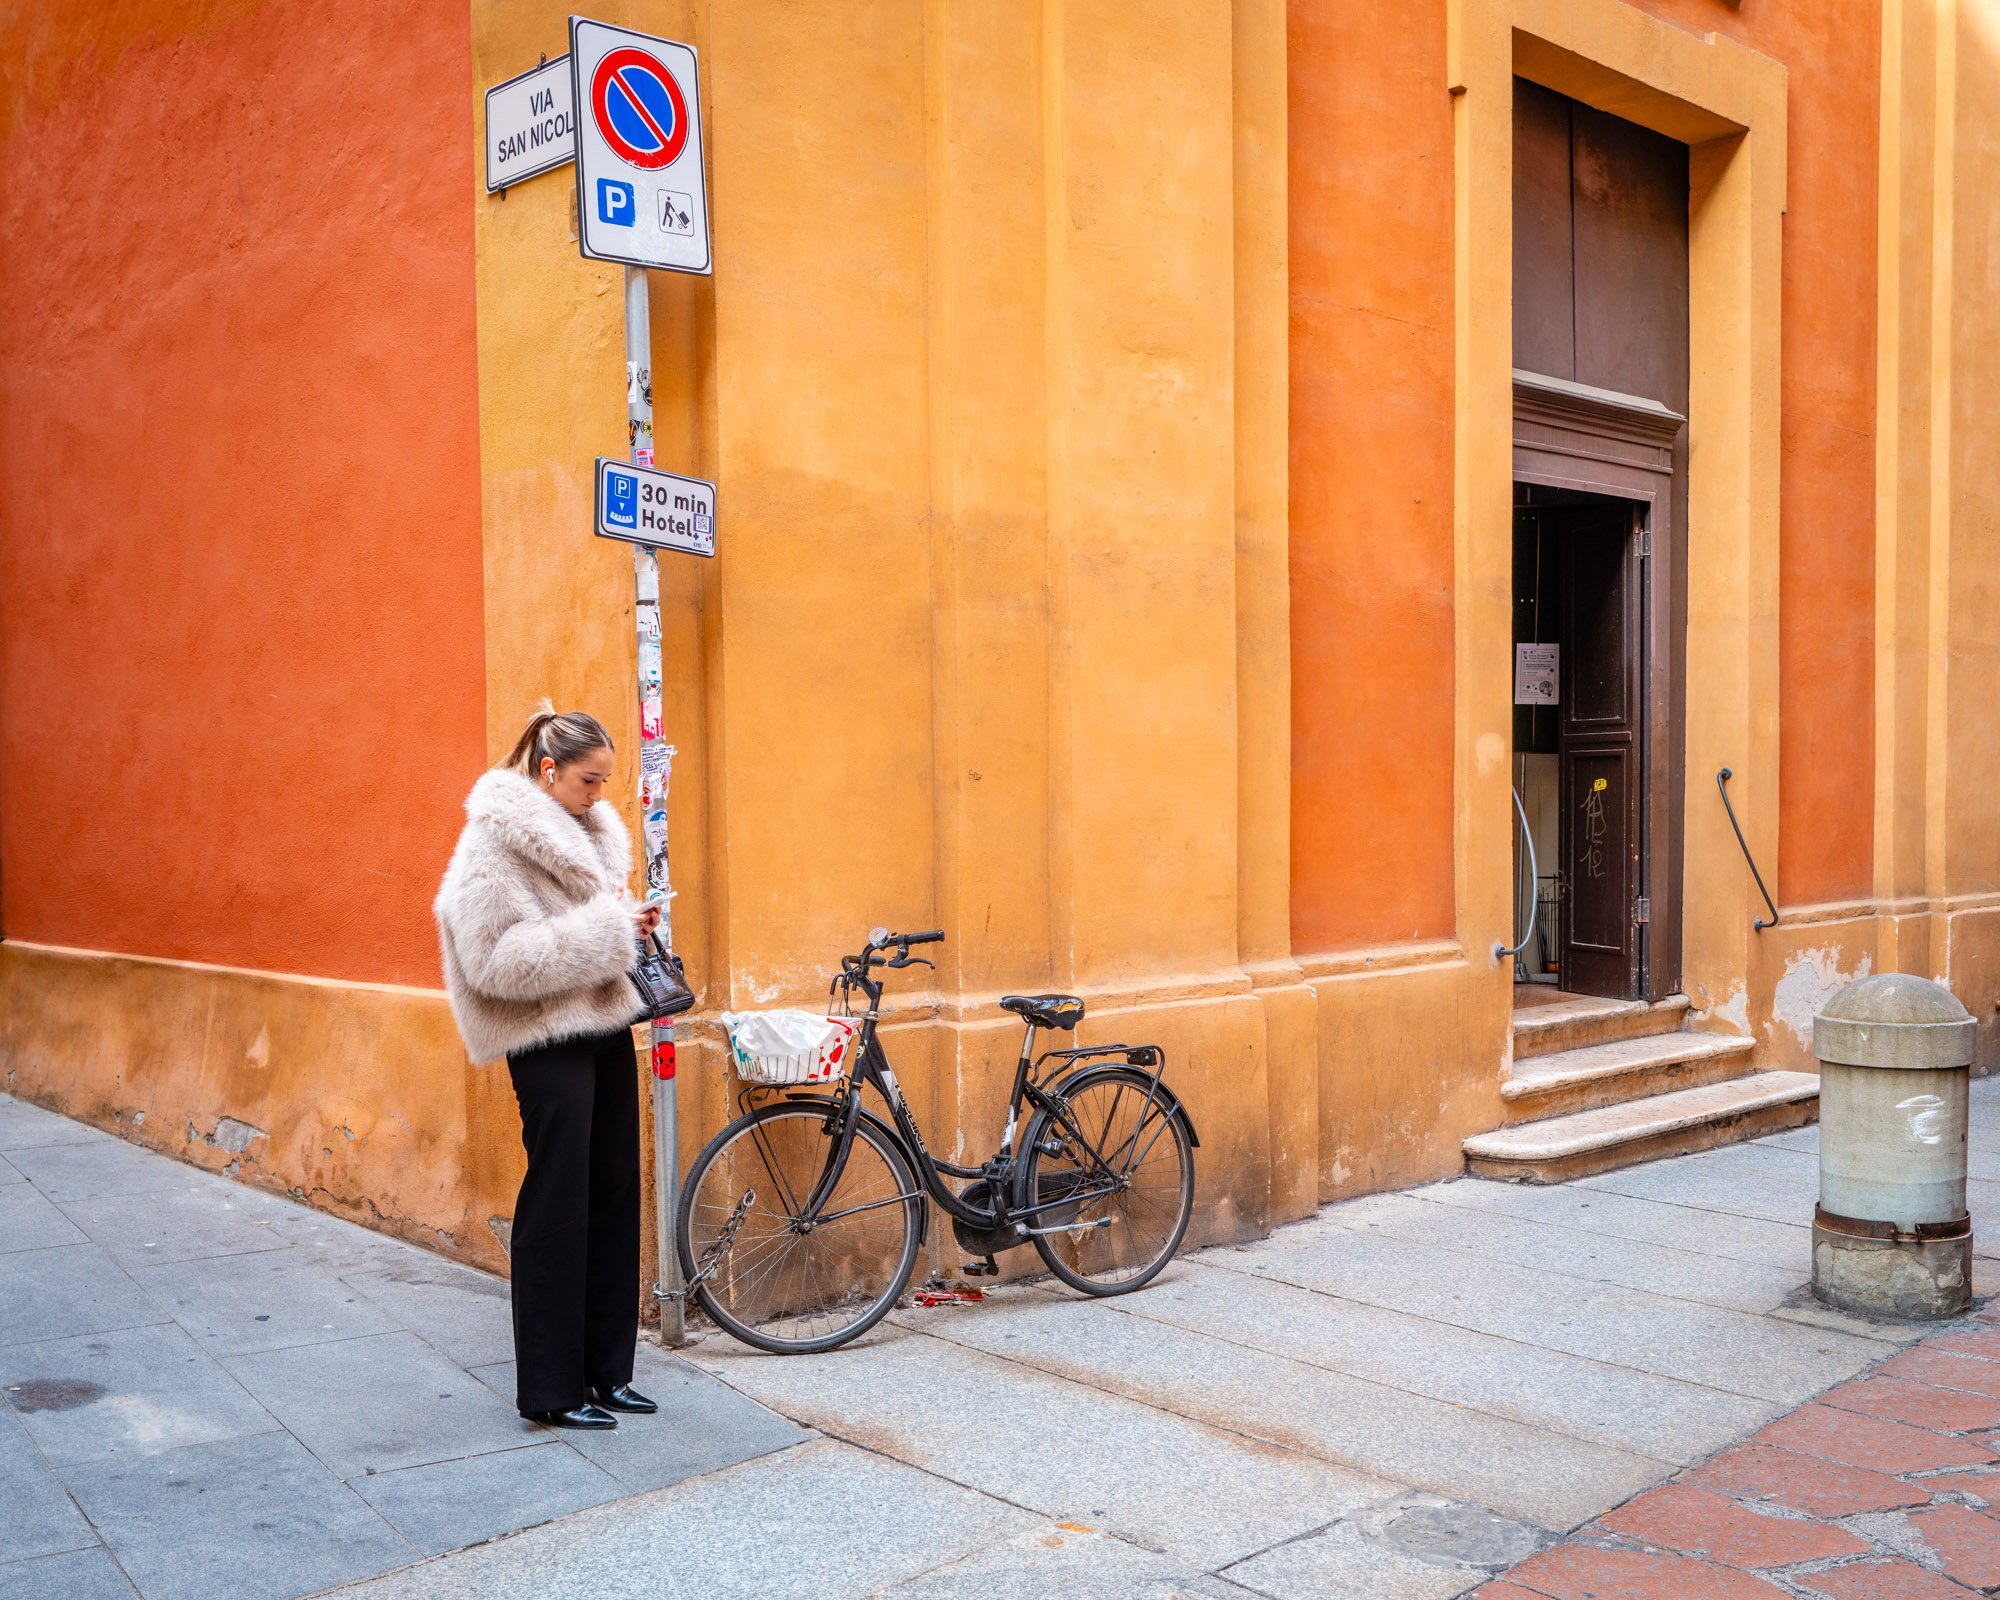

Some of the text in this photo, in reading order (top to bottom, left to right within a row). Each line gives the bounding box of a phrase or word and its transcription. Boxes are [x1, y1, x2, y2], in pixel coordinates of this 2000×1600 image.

[530, 87, 554, 117] VIA
[498, 130, 526, 163] SAN
[605, 186, 627, 218] P
[617, 480, 628, 495] P
[641, 483, 707, 514] 30 min
[642, 508, 692, 537] Hotel
